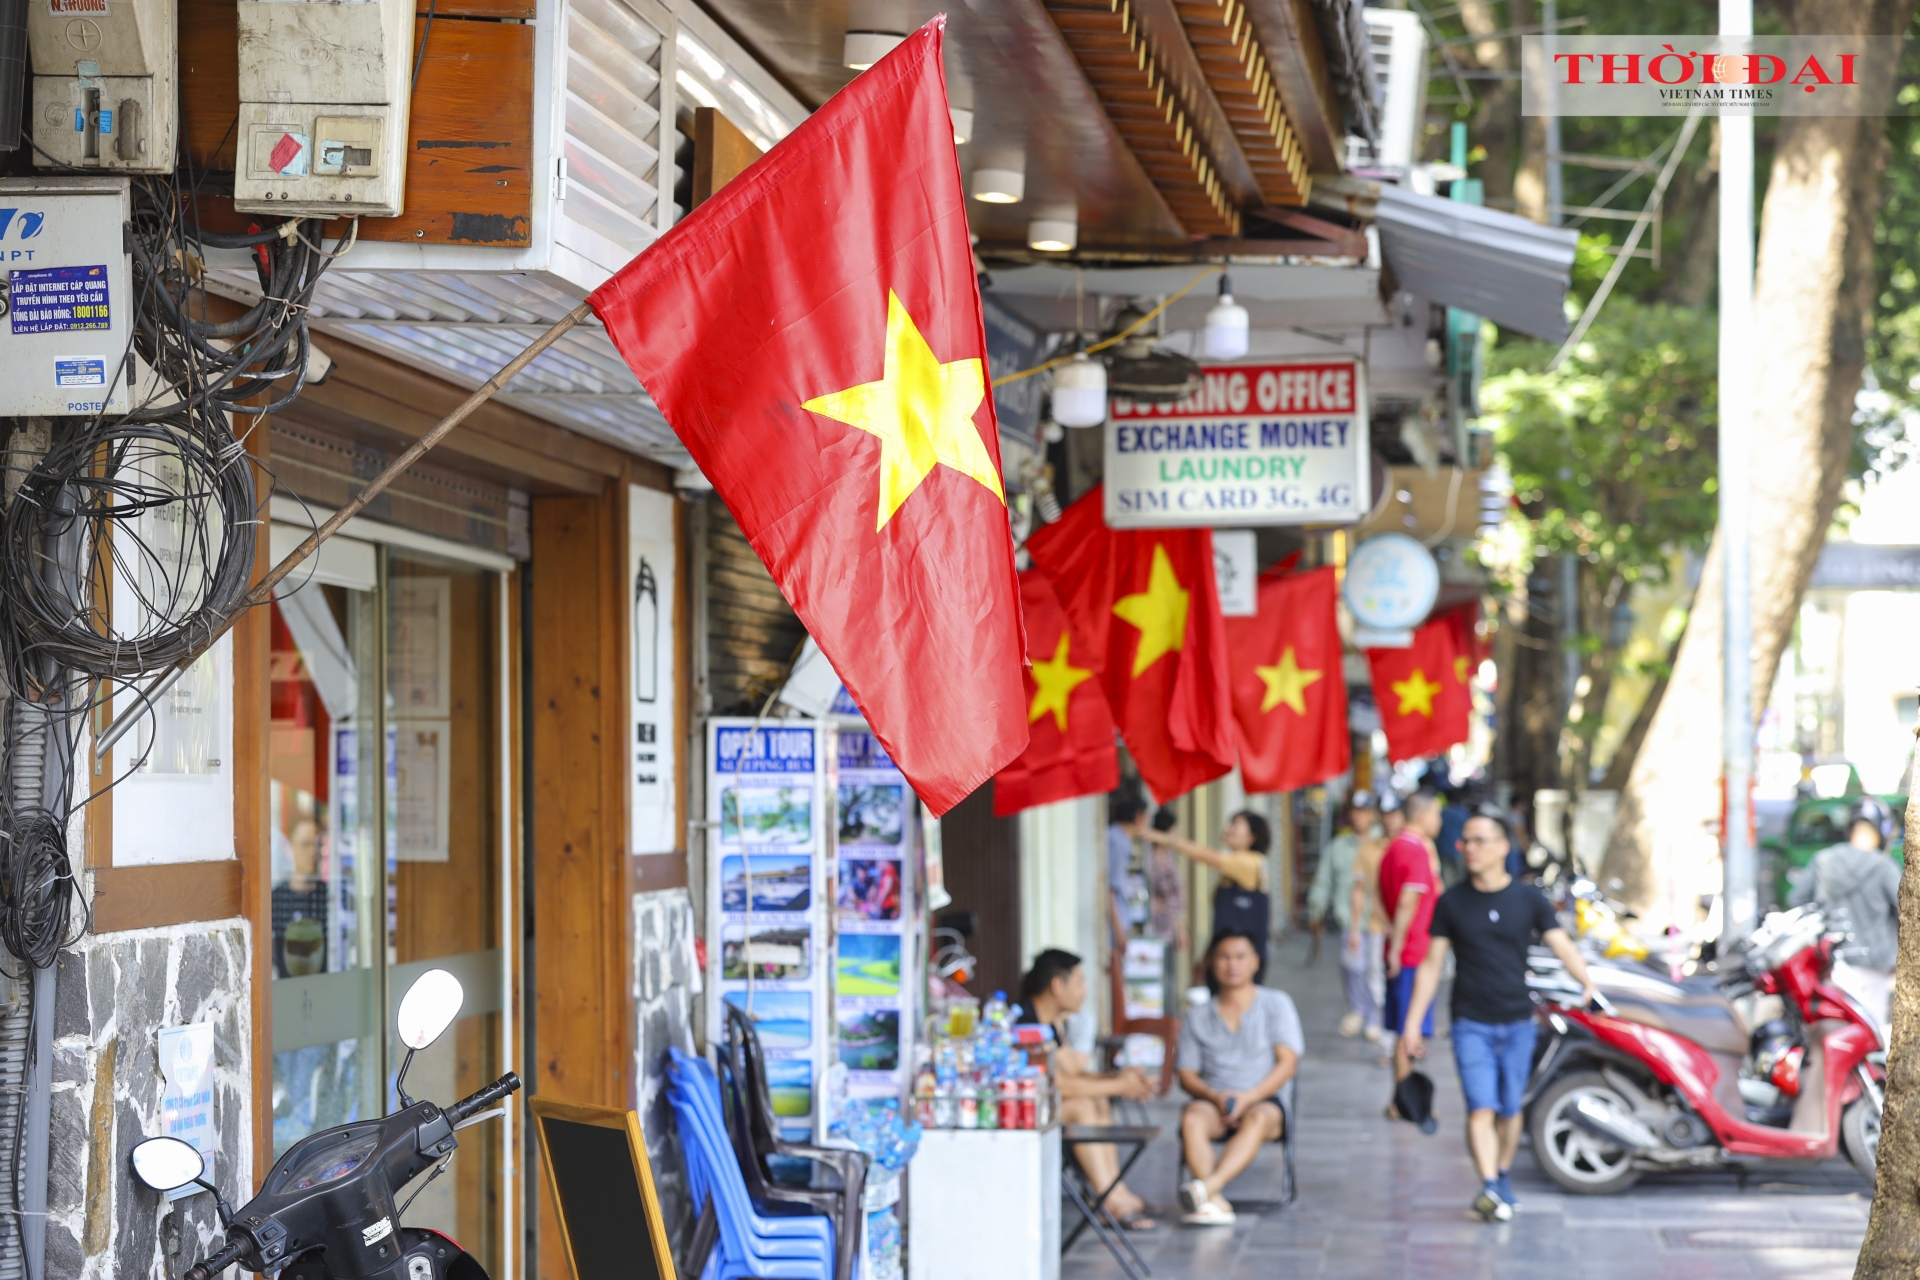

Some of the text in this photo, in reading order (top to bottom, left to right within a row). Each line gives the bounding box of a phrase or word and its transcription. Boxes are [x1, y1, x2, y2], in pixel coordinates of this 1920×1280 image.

[16, 294, 40, 306] TRUYỀN
[42, 294, 58, 304] HÌNH
[59, 294, 75, 304] THEO
[76, 292, 89, 302] YÊU
[39, 282, 68, 292] INTERNET
[70, 280, 84, 291] CÁP
[85, 281, 106, 290] QUANG
[29, 308, 39, 321] ĐÀI
[41, 308, 52, 320] BÁO
[54, 306, 71, 319] HỎNG:
[72, 305, 108, 318] 18001166
[30, 324, 39, 332] HỆ
[1256, 370, 1350, 412] OFFICE
[1116, 420, 1350, 454] EXCHANGE MONEY
[1159, 455, 1306, 482] LAUNDRY
[1117, 488, 1169, 512] SIM
[1178, 486, 1258, 510] CARD
[1316, 482, 1351, 508] 4G
[719, 730, 766, 760] OPEN
[769, 730, 812, 760] TOUR
